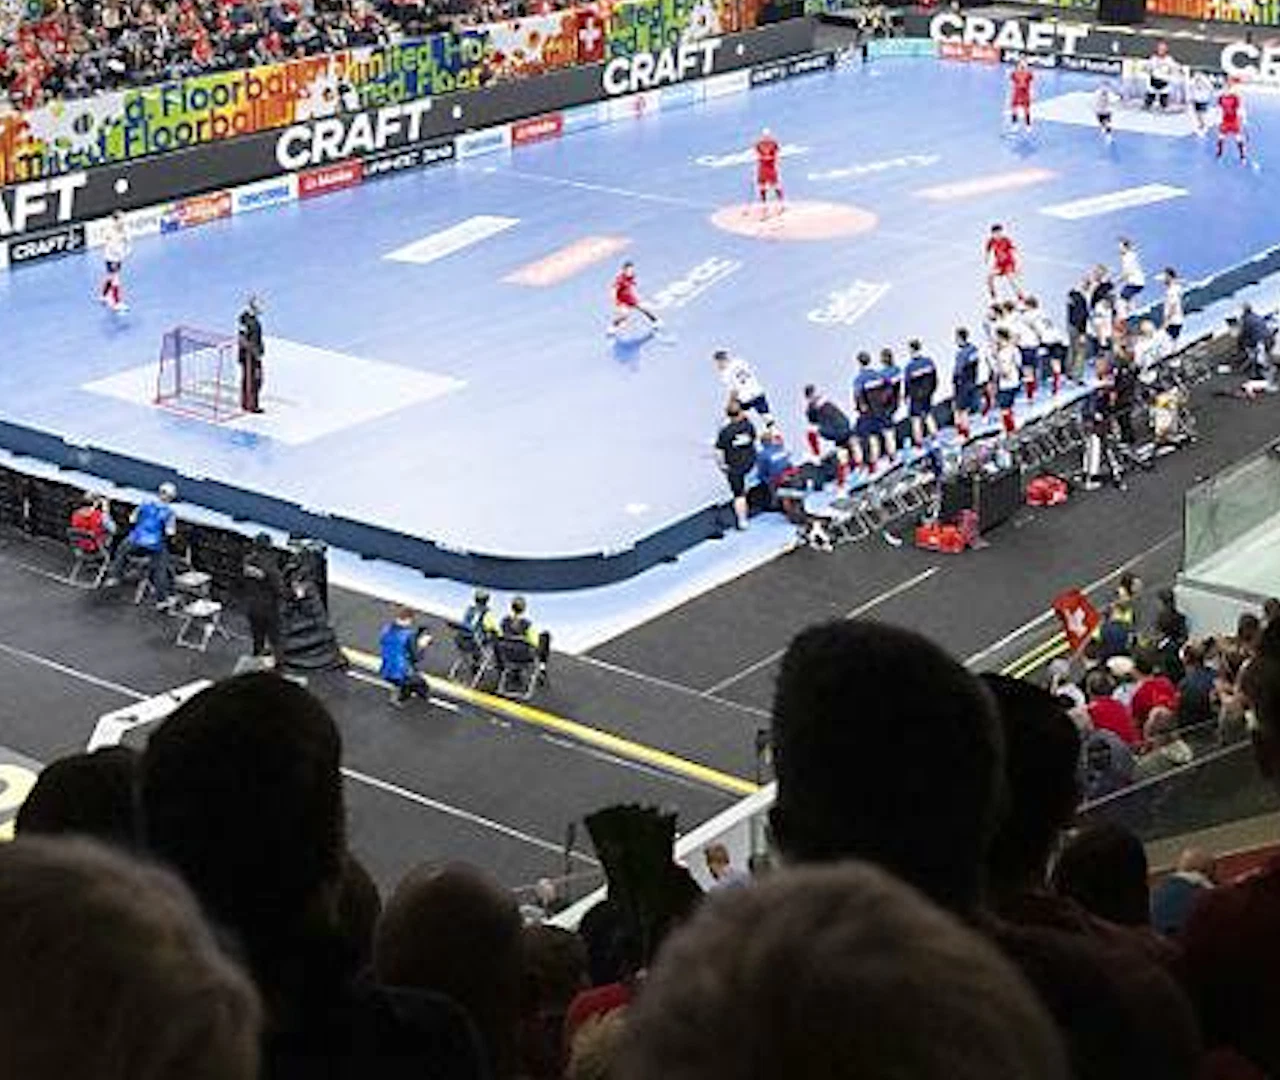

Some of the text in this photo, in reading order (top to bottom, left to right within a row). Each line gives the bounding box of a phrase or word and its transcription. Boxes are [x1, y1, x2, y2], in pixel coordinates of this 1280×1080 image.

[930, 12, 1093, 57] CRAFT
[603, 39, 722, 95] CRAFT
[276, 100, 433, 170] CRAFT
[12, 233, 67, 261] CRAFT
